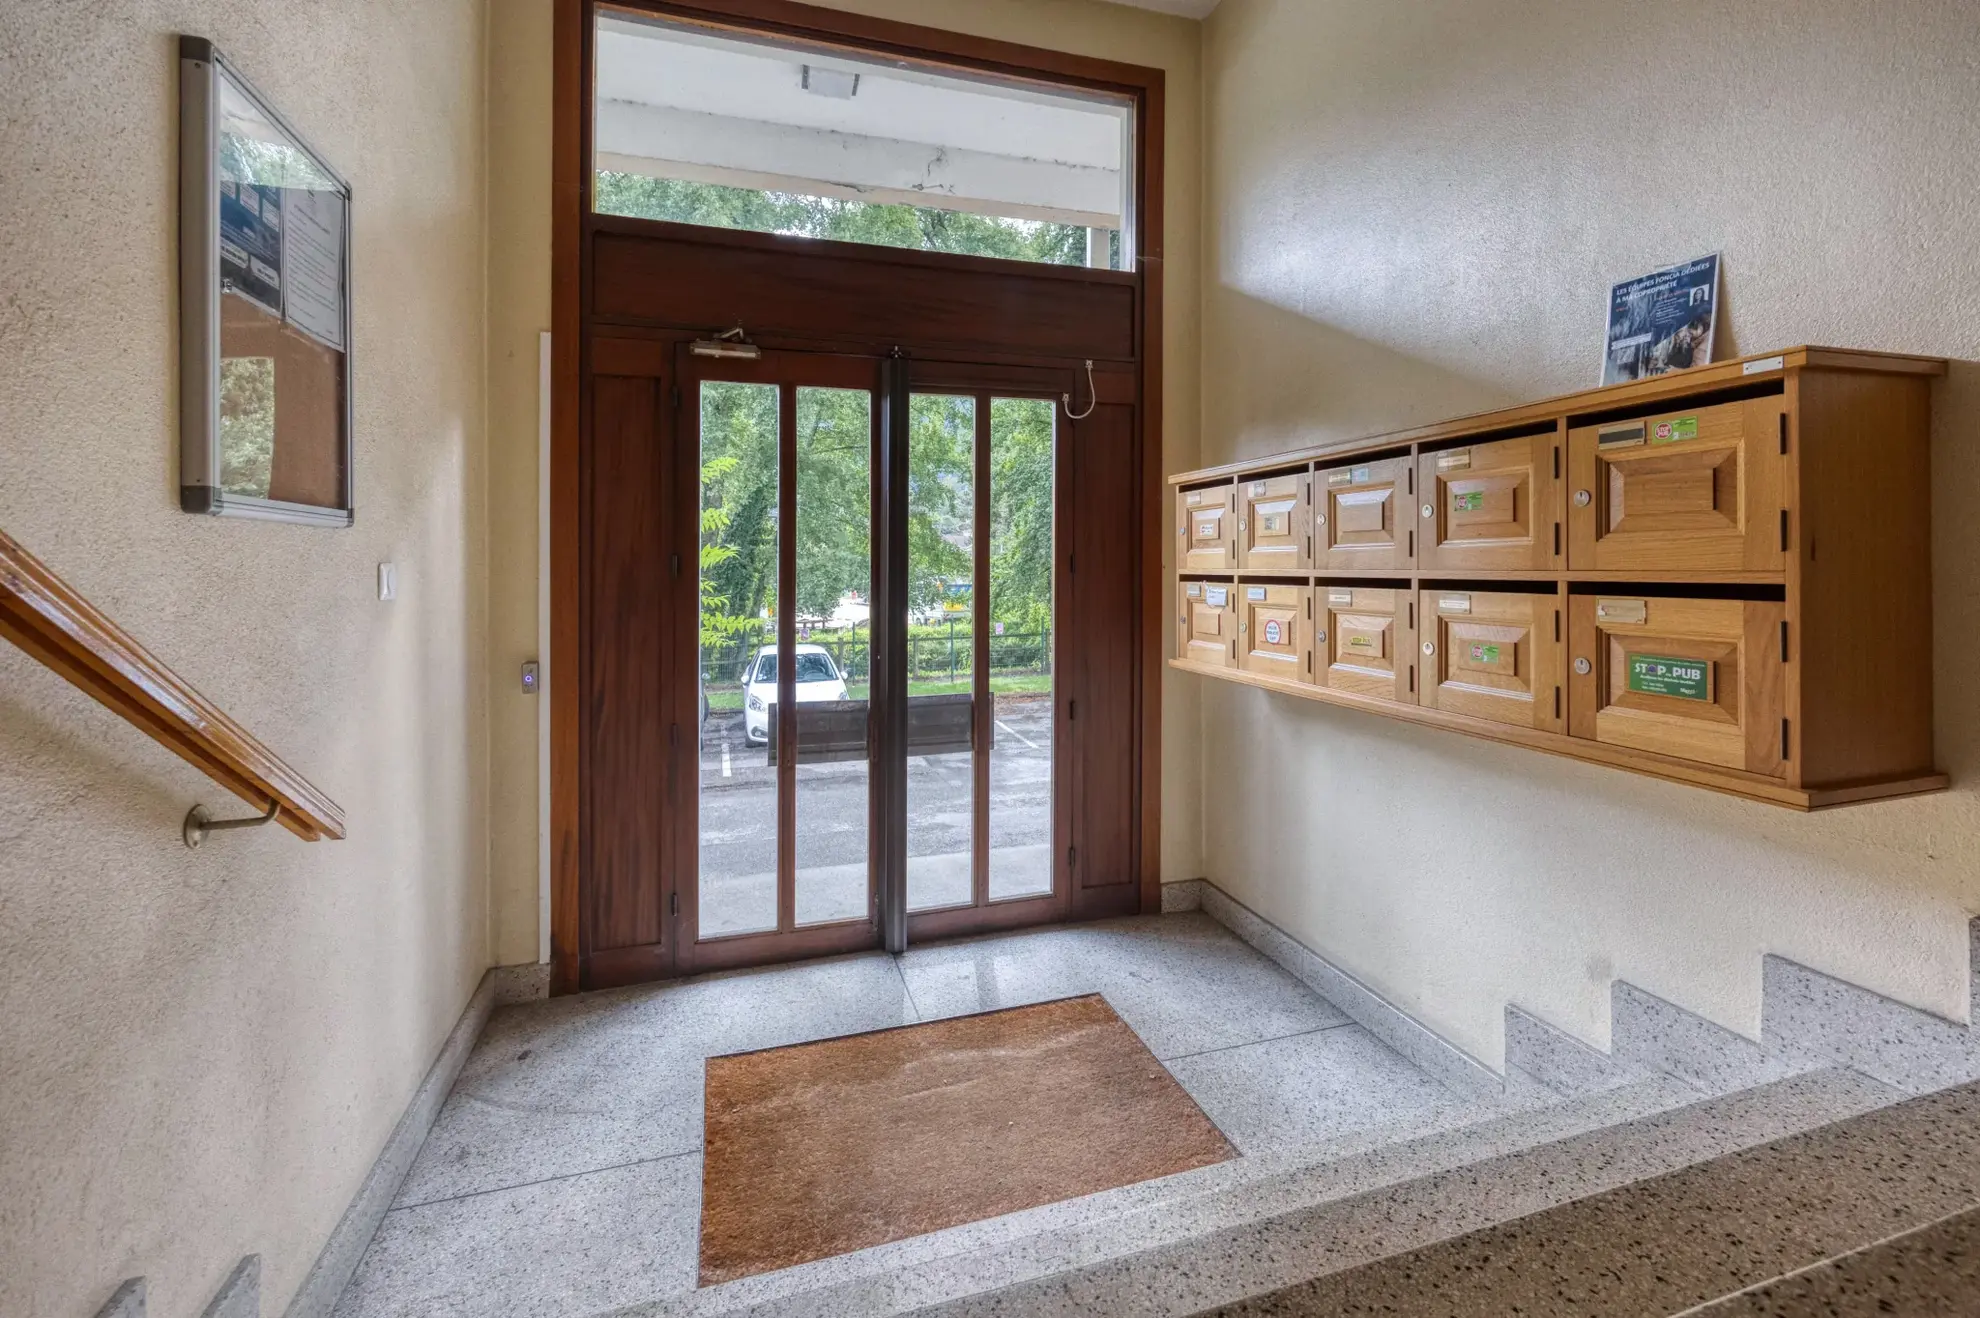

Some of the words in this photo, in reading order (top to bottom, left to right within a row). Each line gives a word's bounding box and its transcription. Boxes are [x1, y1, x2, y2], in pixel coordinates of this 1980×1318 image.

[1617, 288, 1627, 296] LES
[1628, 280, 1655, 293] ÉQUIPES
[1655, 272, 1680, 284] FONCIA
[1681, 262, 1710, 276] DÉDIÉES
[1622, 293, 1633, 302] MA
[1672, 667, 1701, 680] PUB
